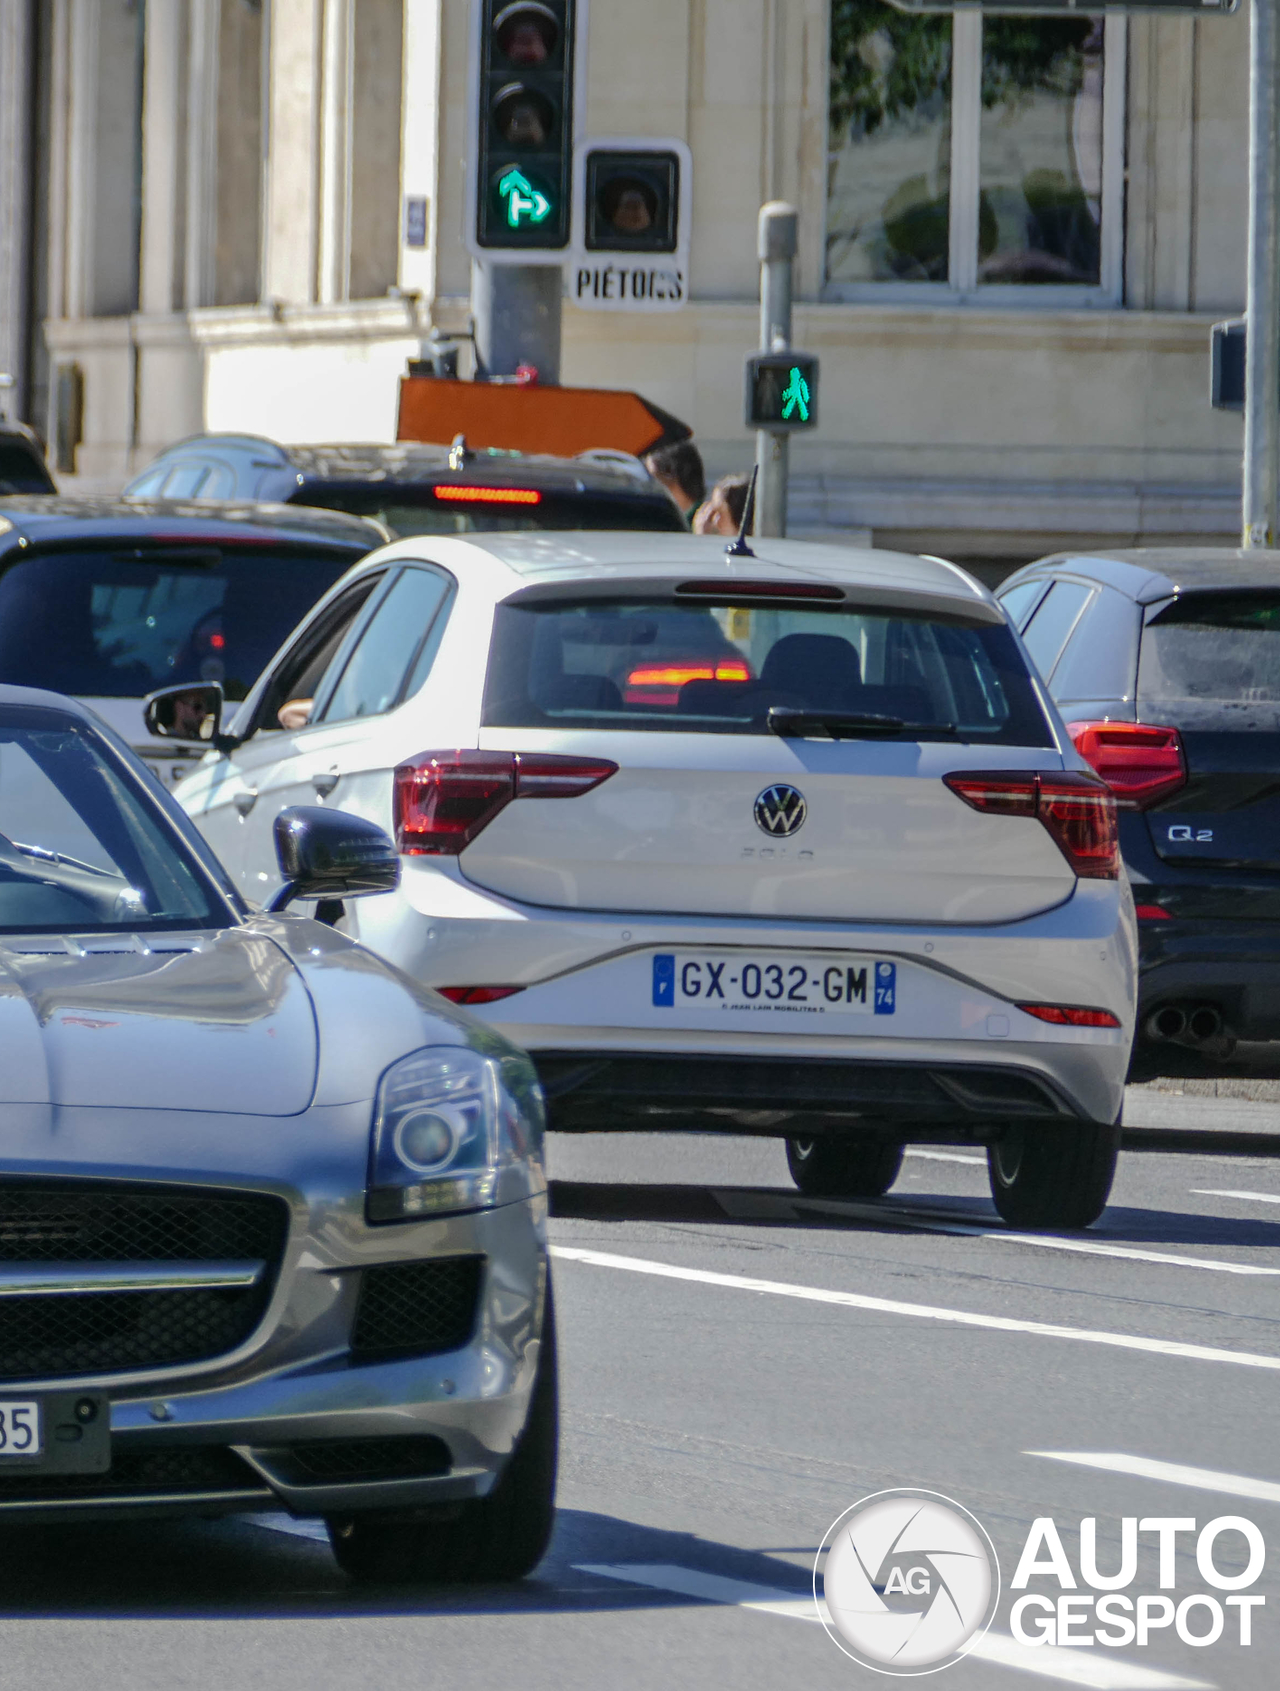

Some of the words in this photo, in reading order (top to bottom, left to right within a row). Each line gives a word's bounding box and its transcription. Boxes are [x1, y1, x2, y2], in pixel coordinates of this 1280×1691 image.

[1168, 825, 1213, 842] Q2
[681, 961, 868, 1004] GX-032-GM
[877, 988, 893, 1006] 74
